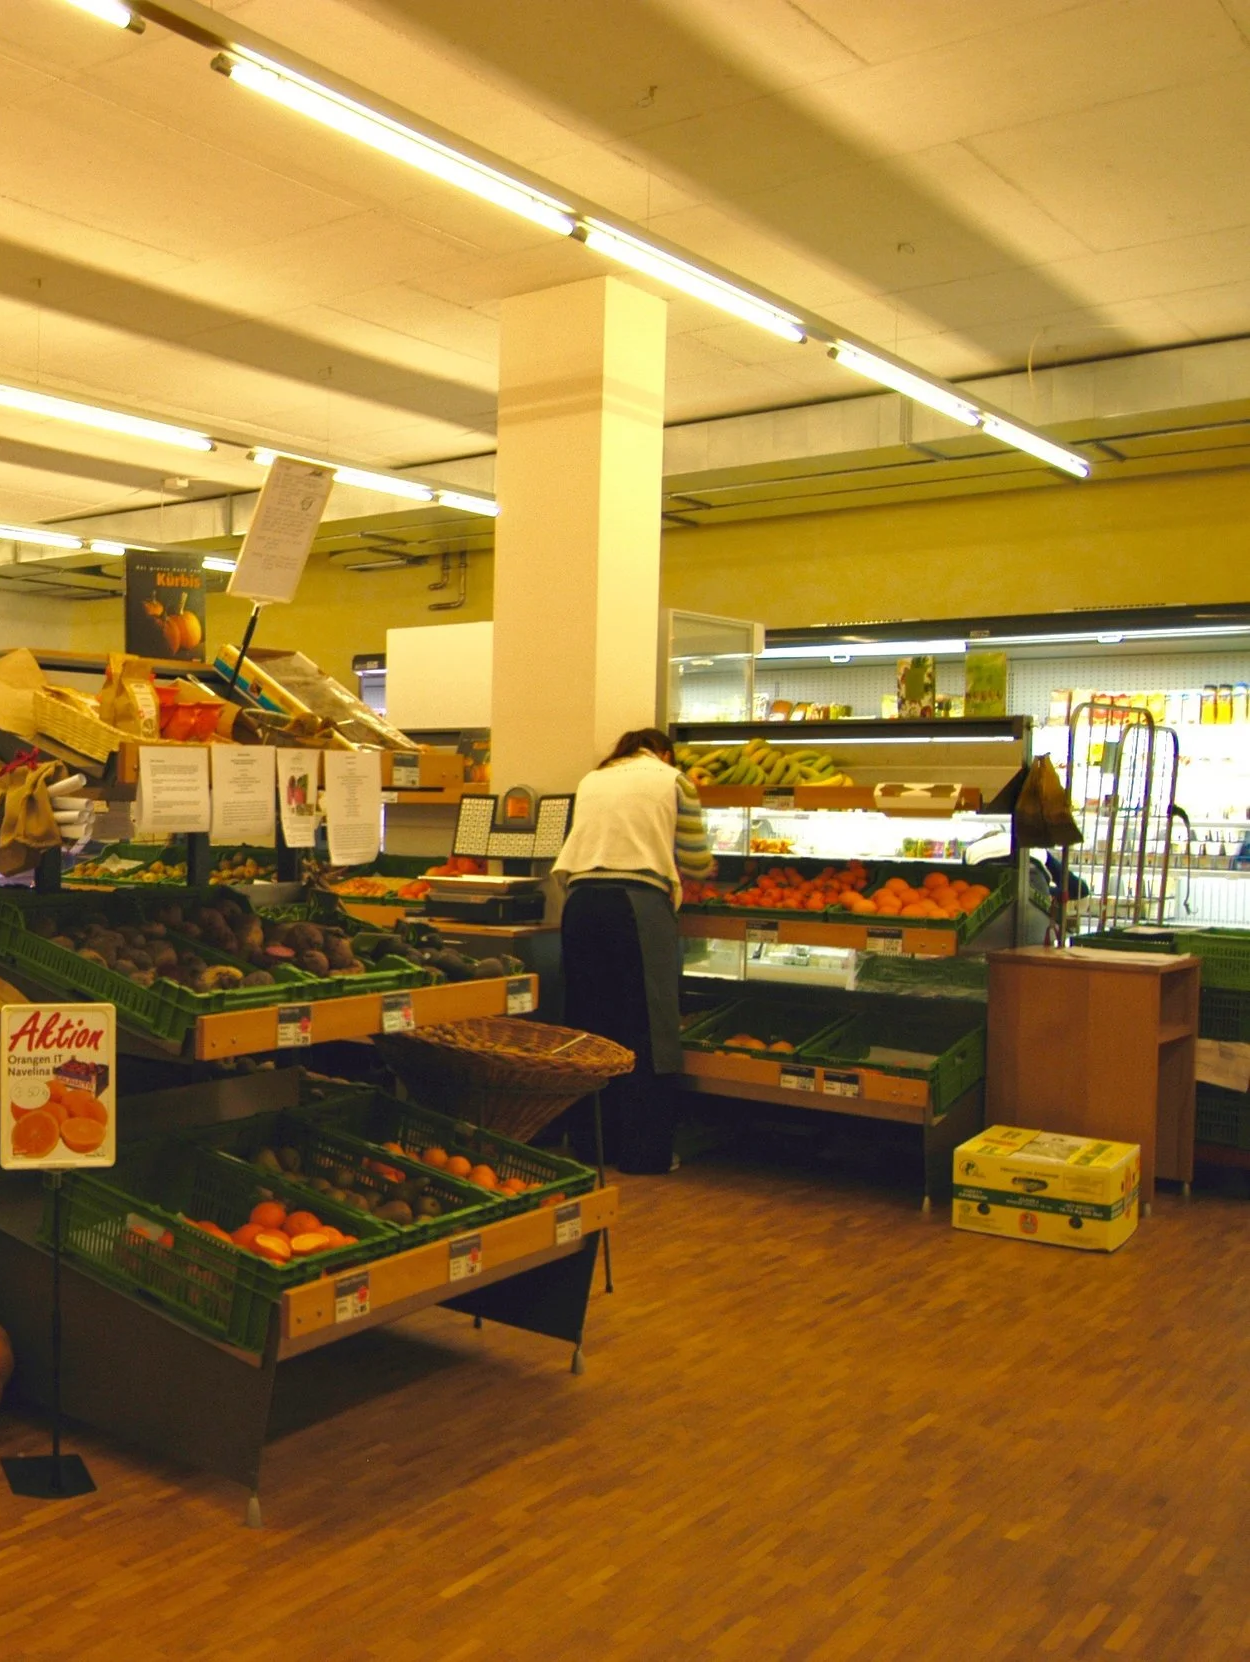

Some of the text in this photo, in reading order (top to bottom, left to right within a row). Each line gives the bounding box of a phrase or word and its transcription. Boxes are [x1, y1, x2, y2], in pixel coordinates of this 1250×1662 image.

[156, 572, 202, 588] Kürbis
[8, 1010, 104, 1052] Aktion
[7, 1054, 63, 1066] Orangen IT
[7, 1067, 51, 1077] Navelina
